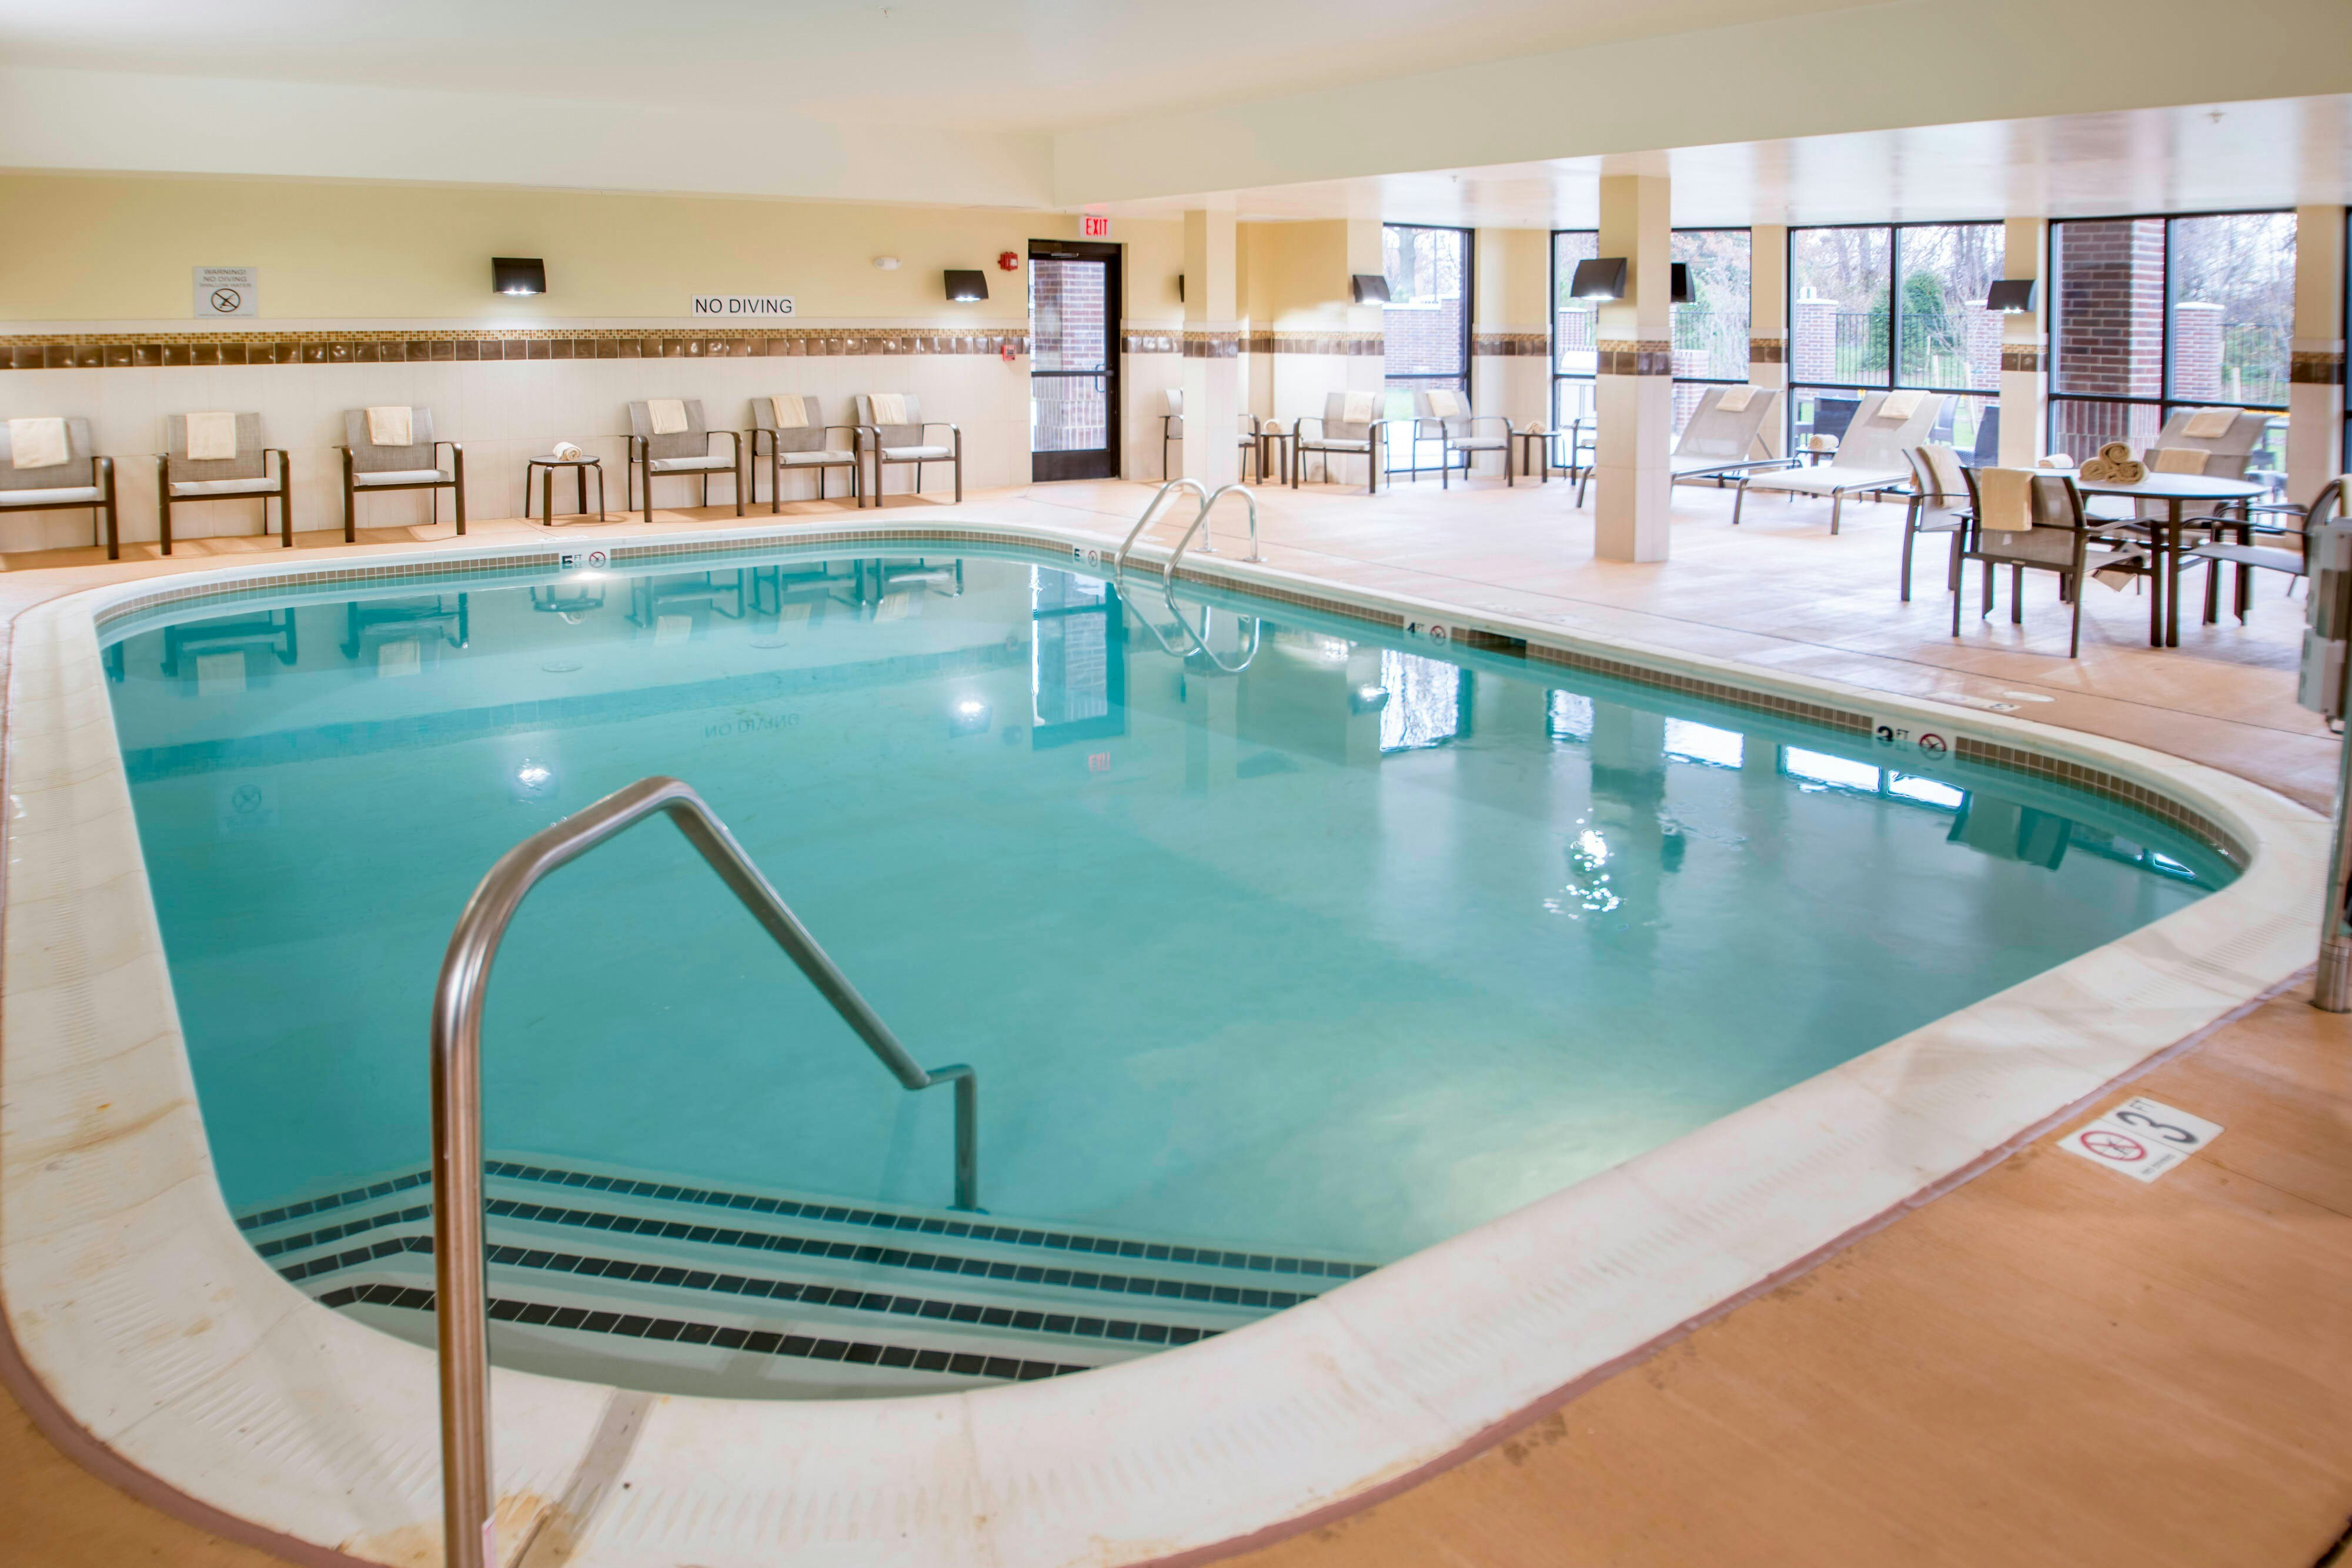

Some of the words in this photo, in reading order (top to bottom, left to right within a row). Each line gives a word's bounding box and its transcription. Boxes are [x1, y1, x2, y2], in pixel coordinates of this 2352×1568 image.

[1085, 218, 1108, 236] EXIT
[696, 299, 723, 313] NO
[729, 299, 792, 313] DIVING
[562, 555, 573, 564] 5
[1896, 729, 1909, 740] FT
[2129, 1099, 2156, 1113] FT
[2116, 1111, 2199, 1144] 3
